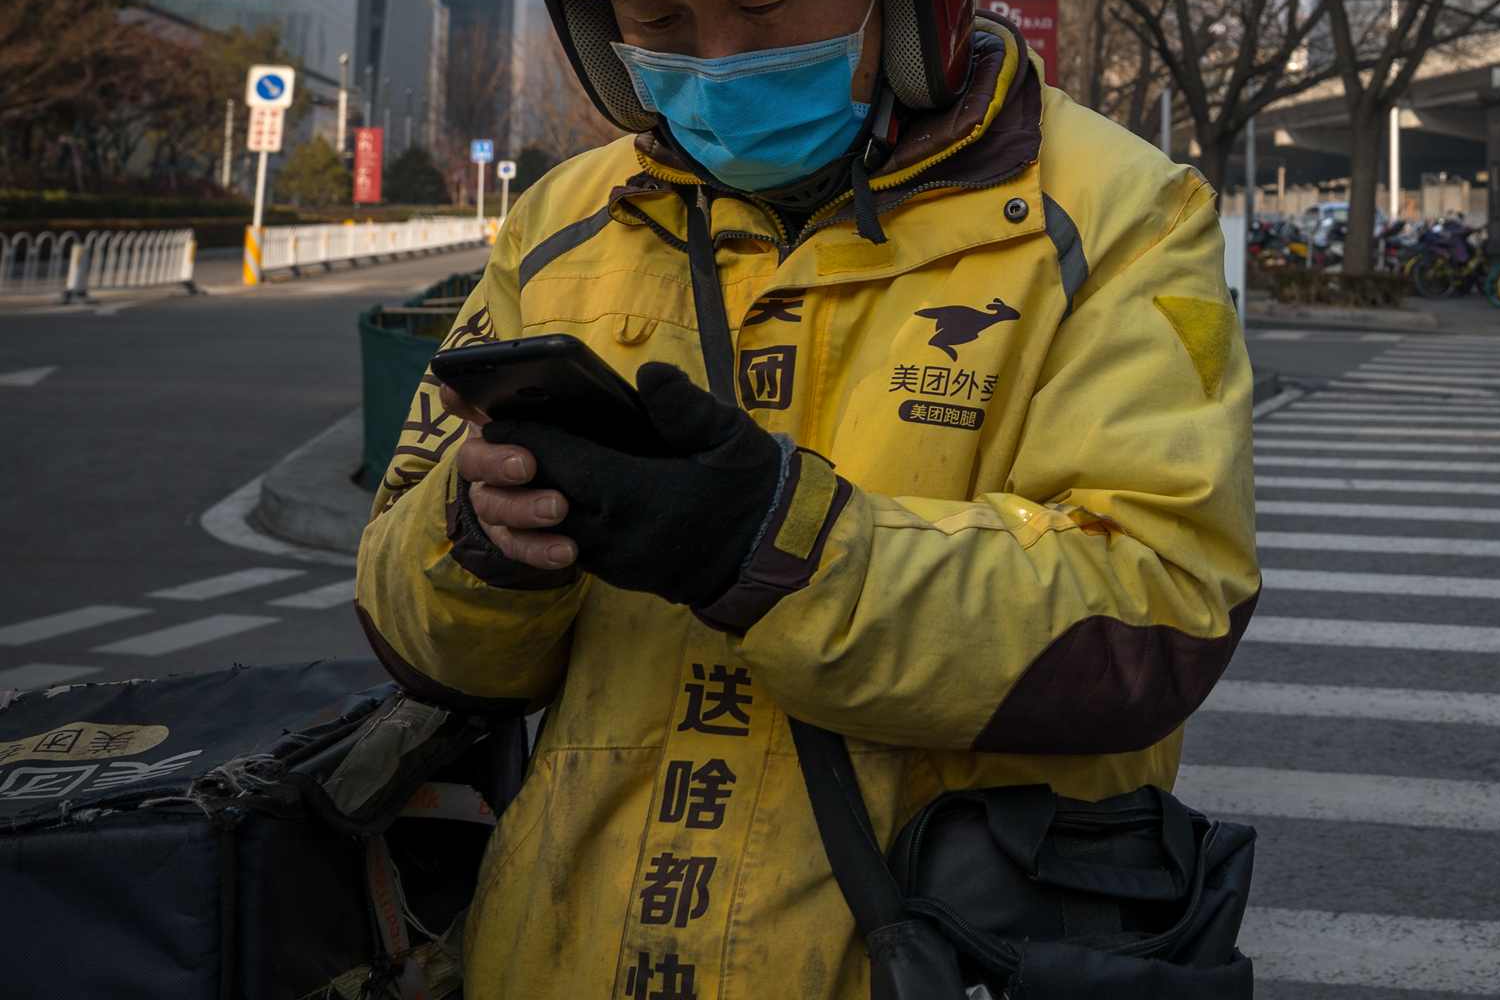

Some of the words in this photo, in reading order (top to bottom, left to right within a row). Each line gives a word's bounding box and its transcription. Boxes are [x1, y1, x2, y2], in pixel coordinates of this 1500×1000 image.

[909, 404, 978, 427] 美团跑腿
[624, 662, 753, 1000] 送啥都快
